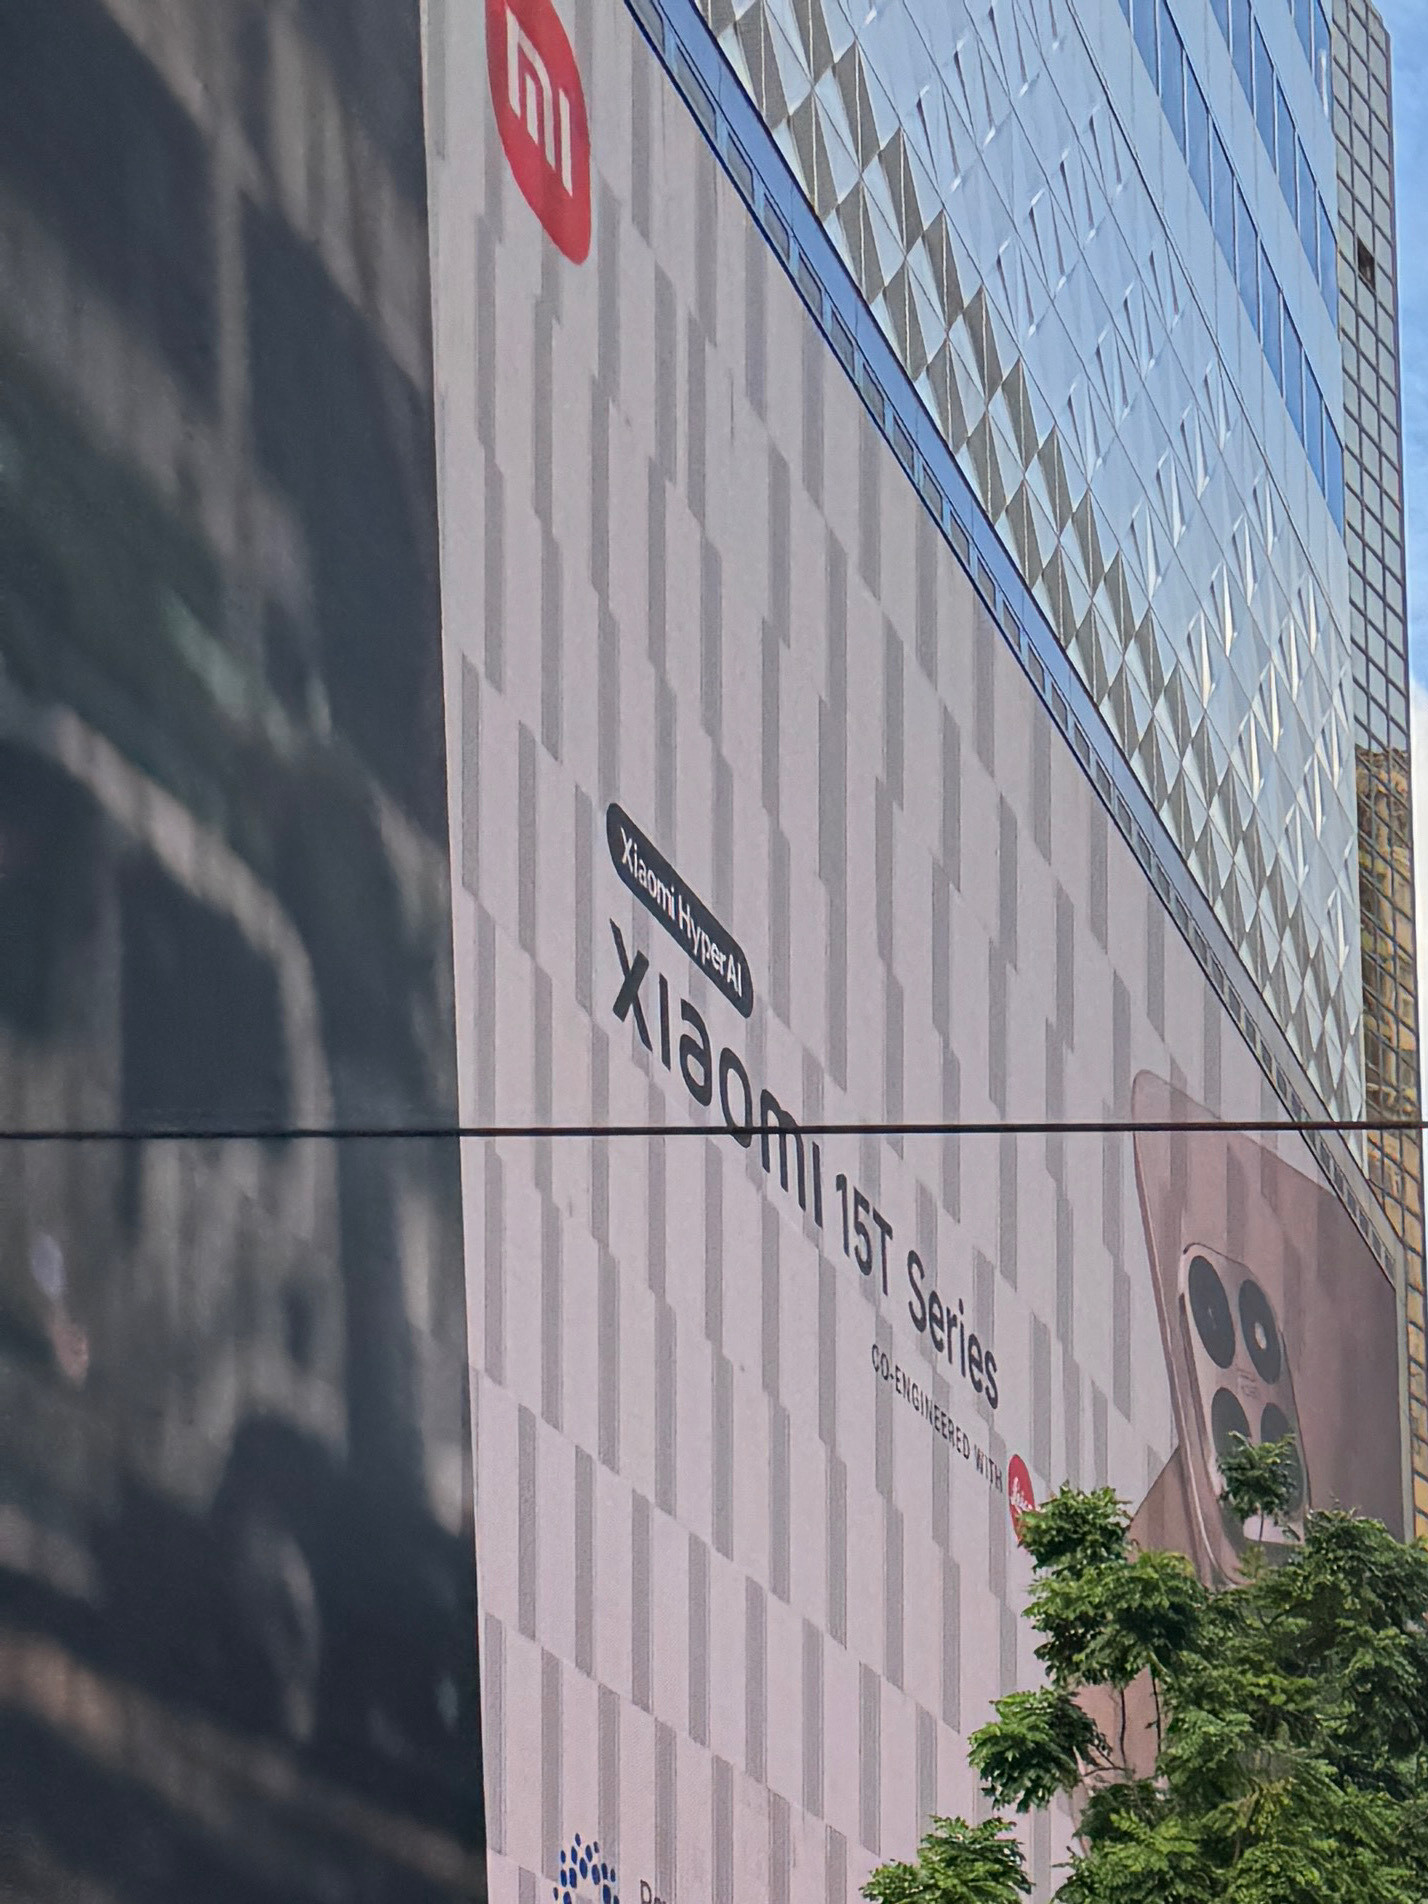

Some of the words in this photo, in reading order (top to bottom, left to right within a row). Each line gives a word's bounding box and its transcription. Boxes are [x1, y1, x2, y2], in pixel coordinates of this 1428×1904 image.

[618, 826, 676, 915] Xiaomi
[676, 902, 744, 991] HyperAI
[836, 1172, 892, 1296] 15T
[908, 1248, 1000, 1410] Series
[870, 1343, 971, 1461] CO-ENGINEERED
[974, 1443, 1004, 1494] WITH
